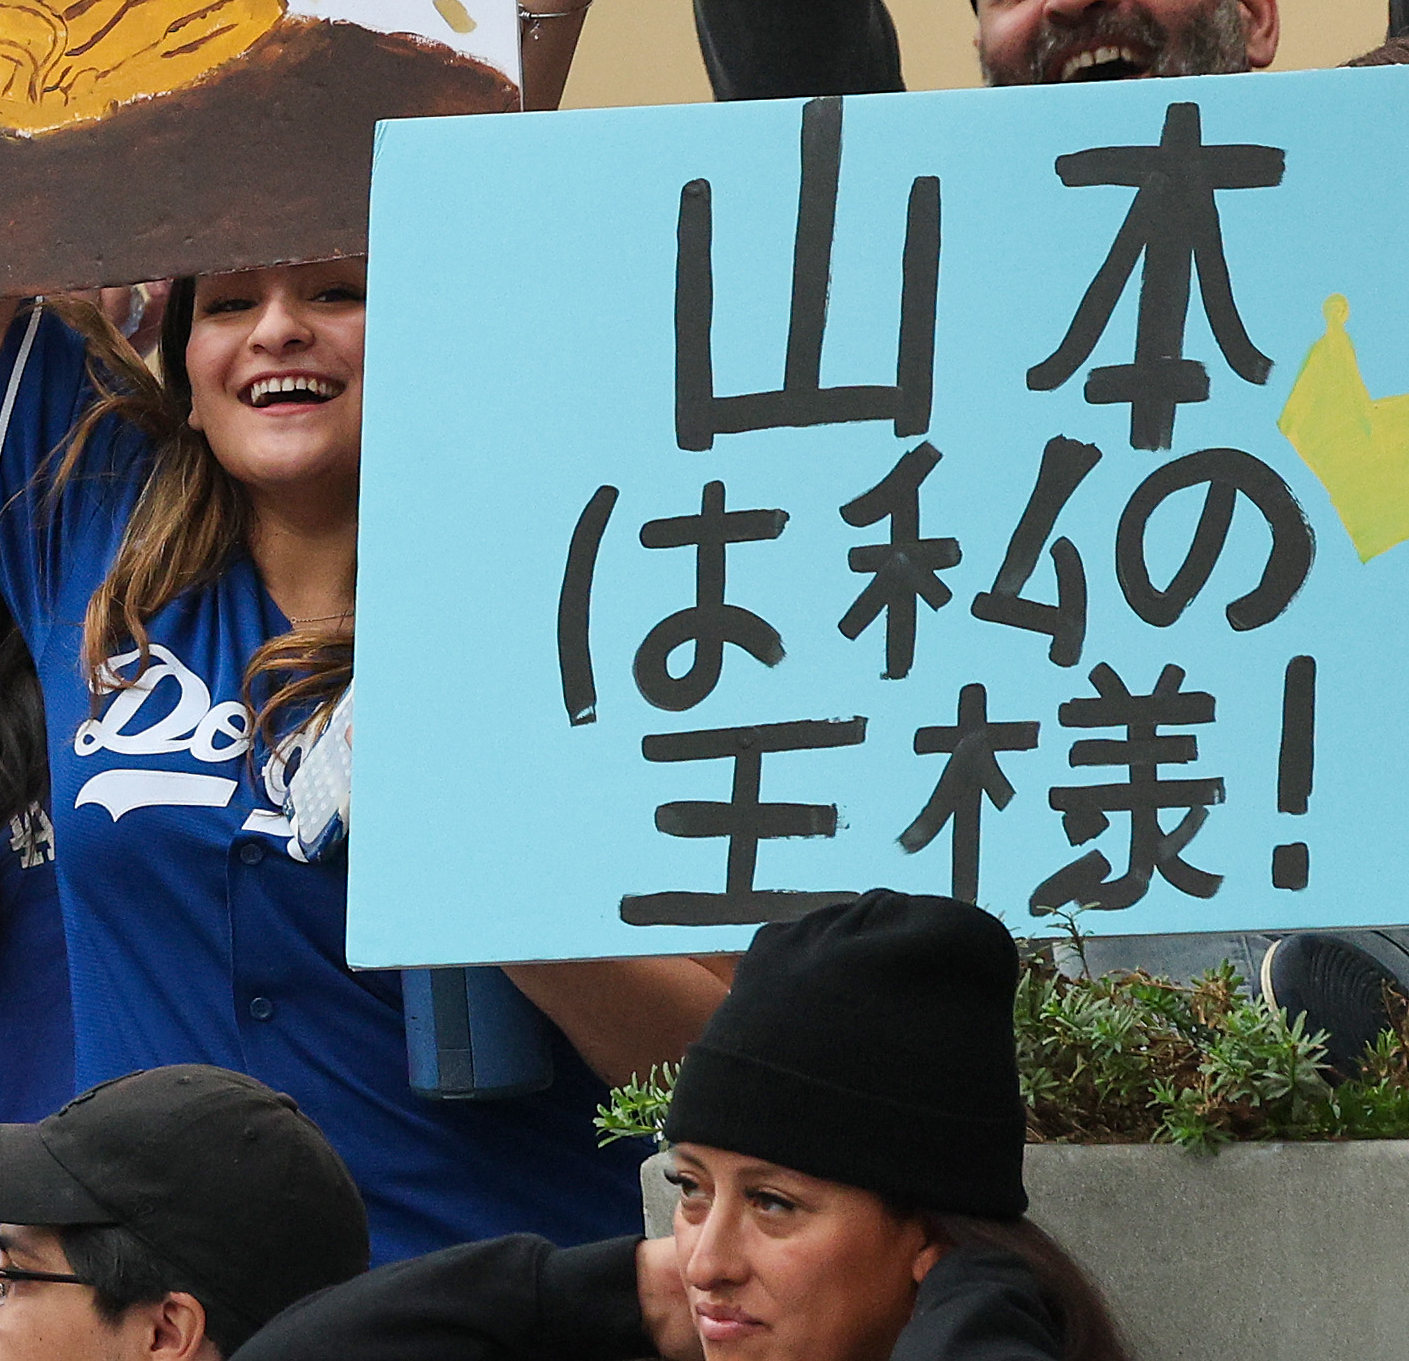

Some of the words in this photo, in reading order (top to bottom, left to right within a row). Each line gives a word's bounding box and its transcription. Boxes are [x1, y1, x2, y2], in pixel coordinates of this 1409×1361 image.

[673, 97, 1286, 451] 山本
[557, 435, 1316, 727] は私の
[618, 653, 1316, 927] 王様!
